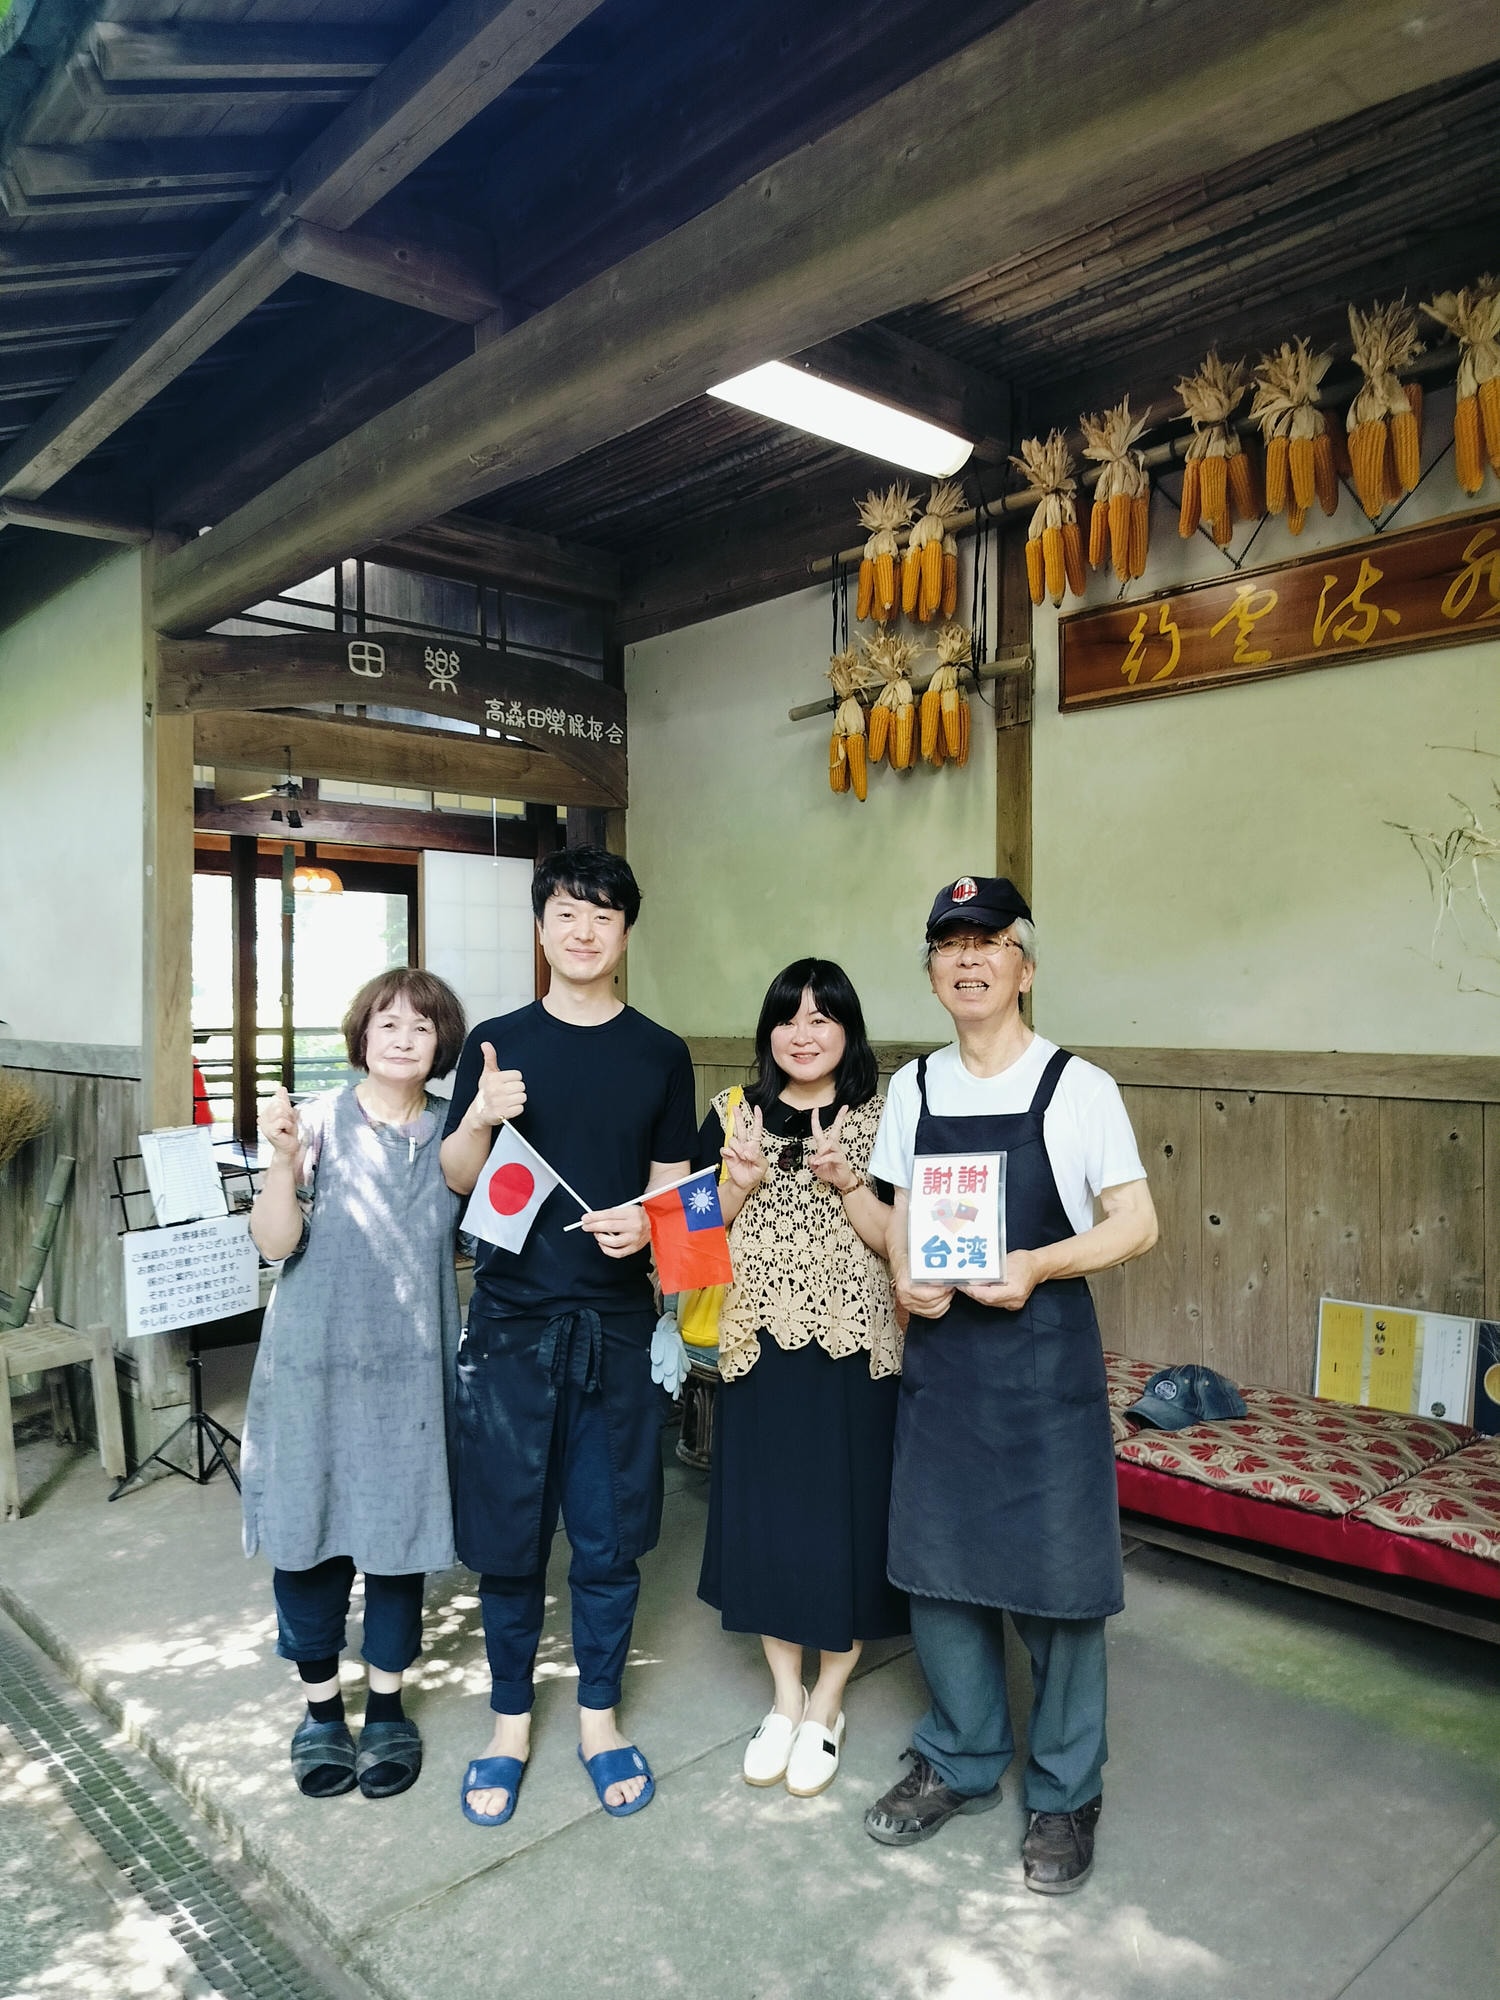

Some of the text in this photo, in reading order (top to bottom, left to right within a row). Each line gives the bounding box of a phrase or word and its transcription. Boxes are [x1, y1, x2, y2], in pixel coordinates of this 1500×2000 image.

[922, 1164, 989, 1196] 謝謝
[132, 1235, 250, 1262] ご来店ありがとうございます。
[172, 1226, 217, 1242] お客様各位
[920, 1234, 988, 1269] 台湾
